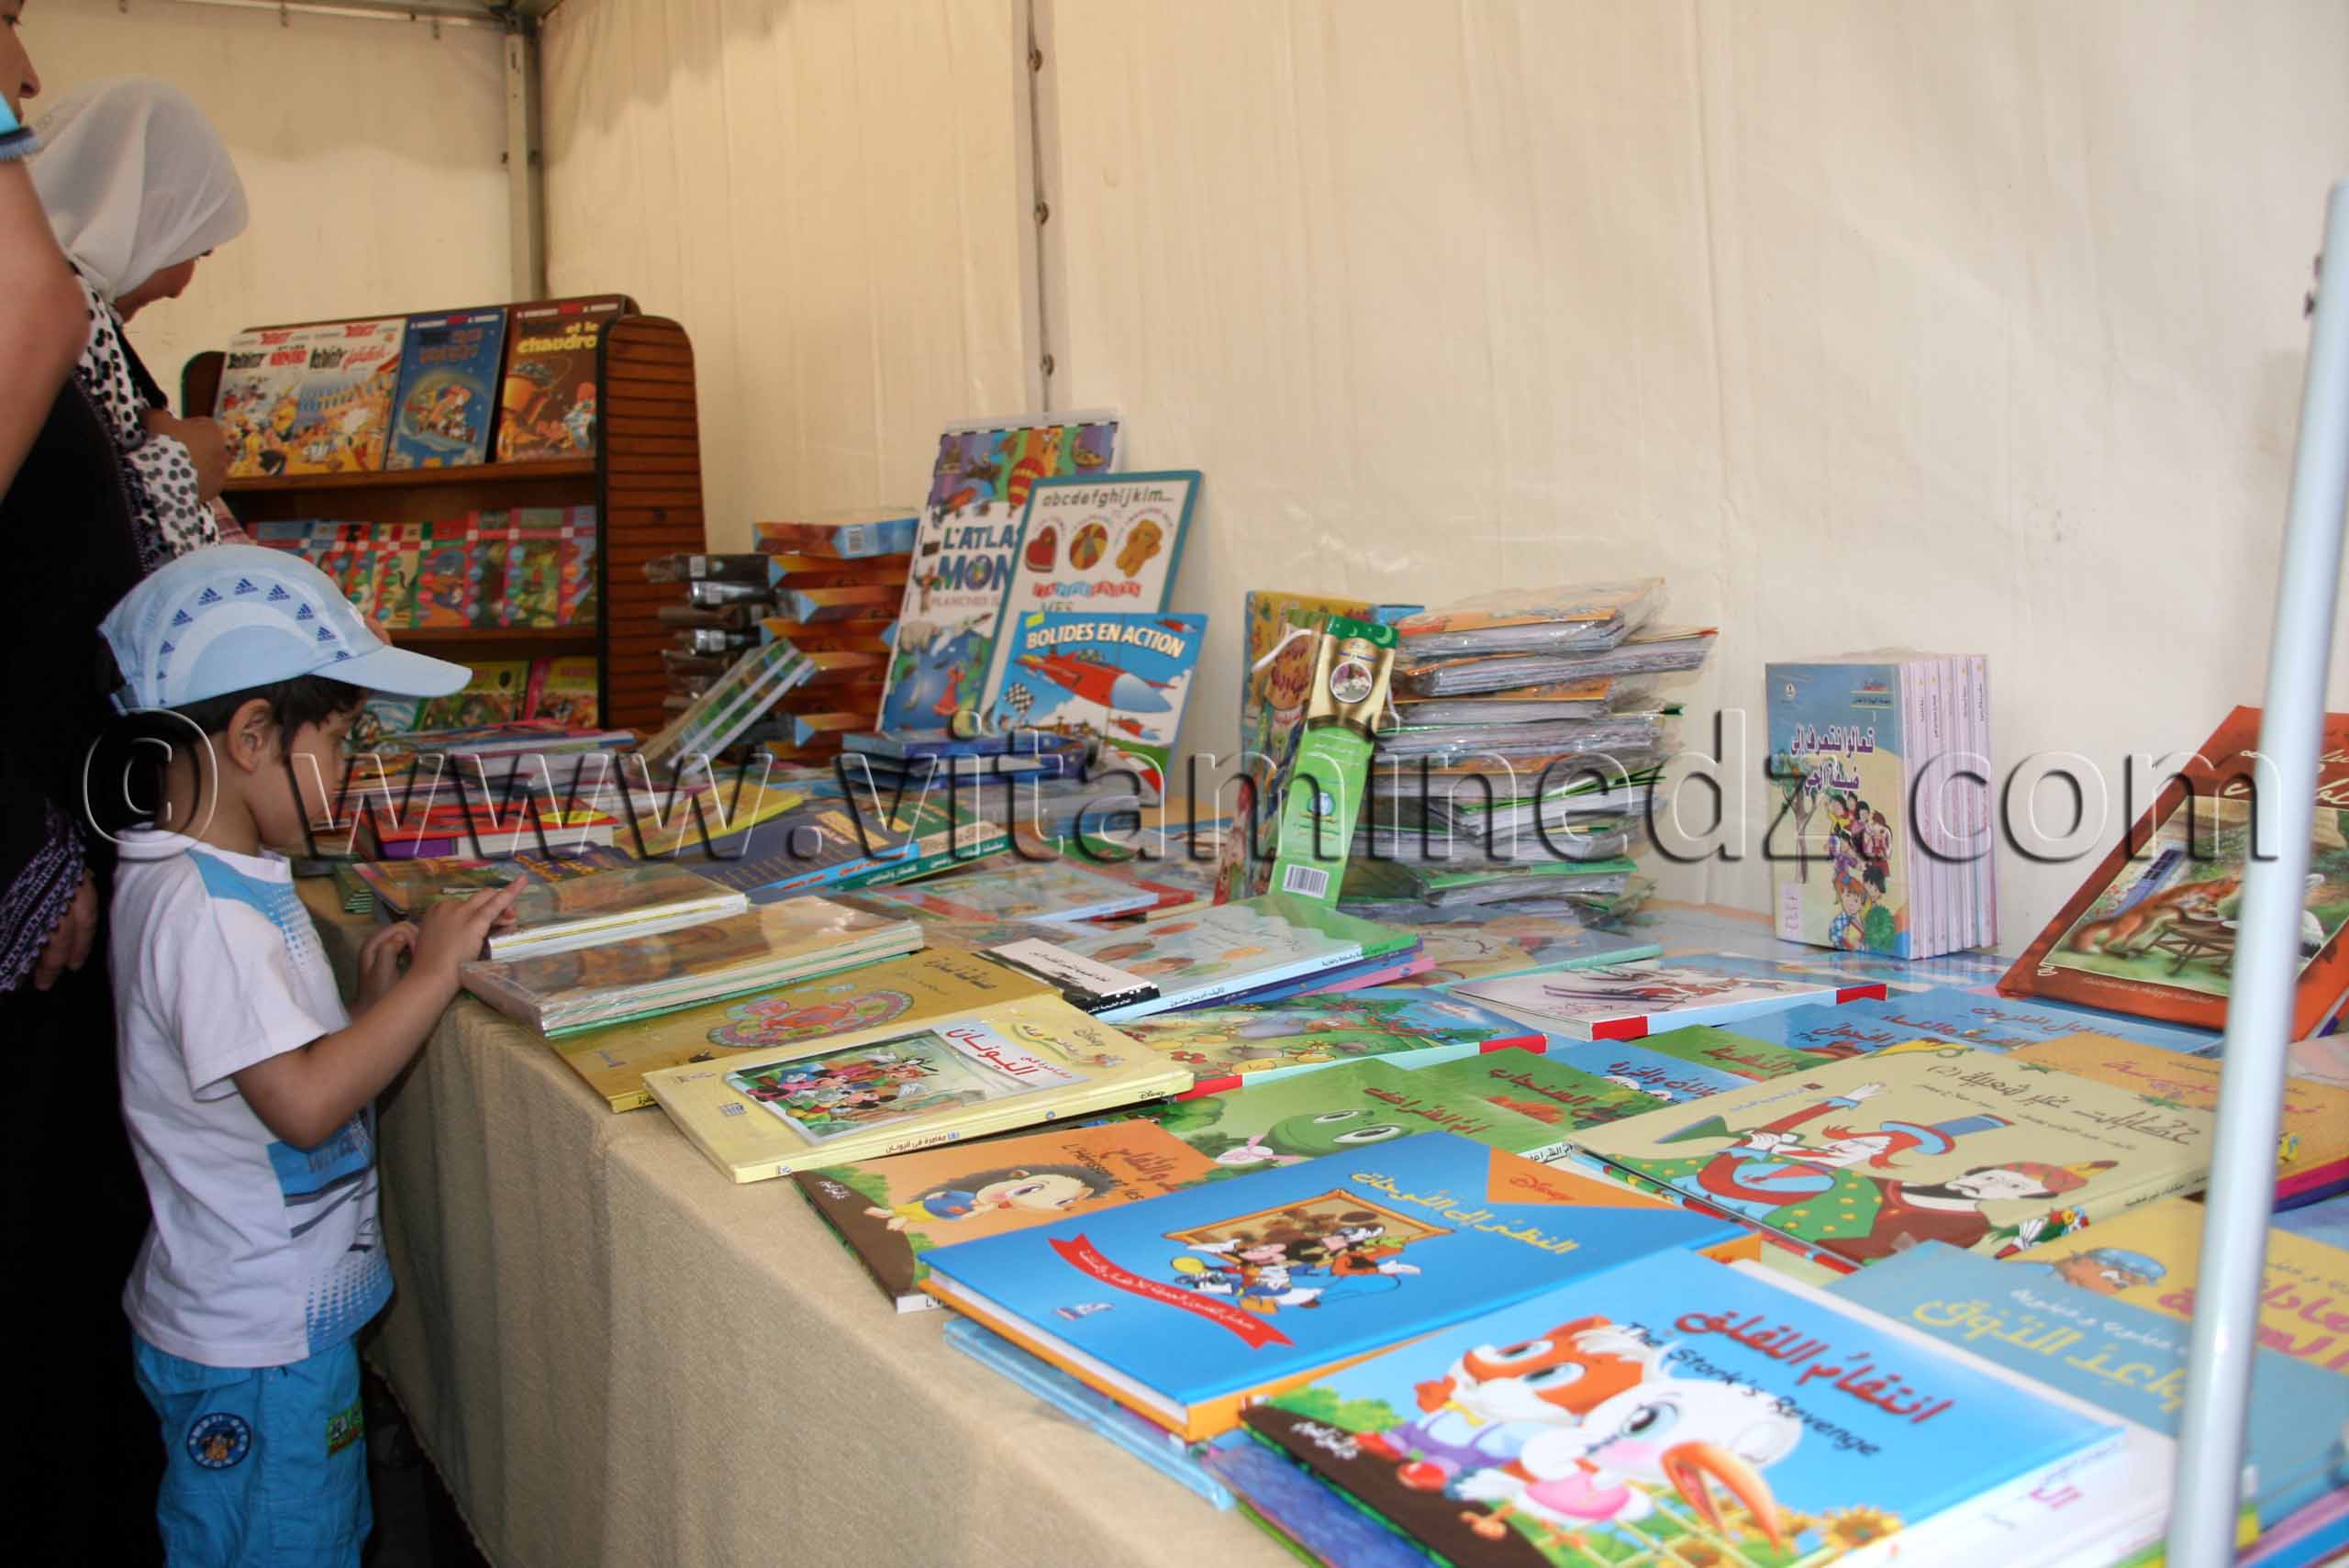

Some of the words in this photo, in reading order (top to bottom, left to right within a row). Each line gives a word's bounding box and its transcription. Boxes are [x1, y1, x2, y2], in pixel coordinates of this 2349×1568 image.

[517, 334, 597, 354] chaudro
[942, 524, 1014, 550] L'ATLA
[933, 553, 1010, 592] MON
[1026, 621, 1096, 650] BOLIDES
[1096, 621, 1122, 641] EN
[1120, 625, 1186, 659] ACTION
[946, 1028, 1040, 1076] اليونان
[1508, 1173, 1577, 1202] Disney
[1675, 1310, 1831, 1365] اللقلق
[1768, 1396, 1882, 1457] Revenge
